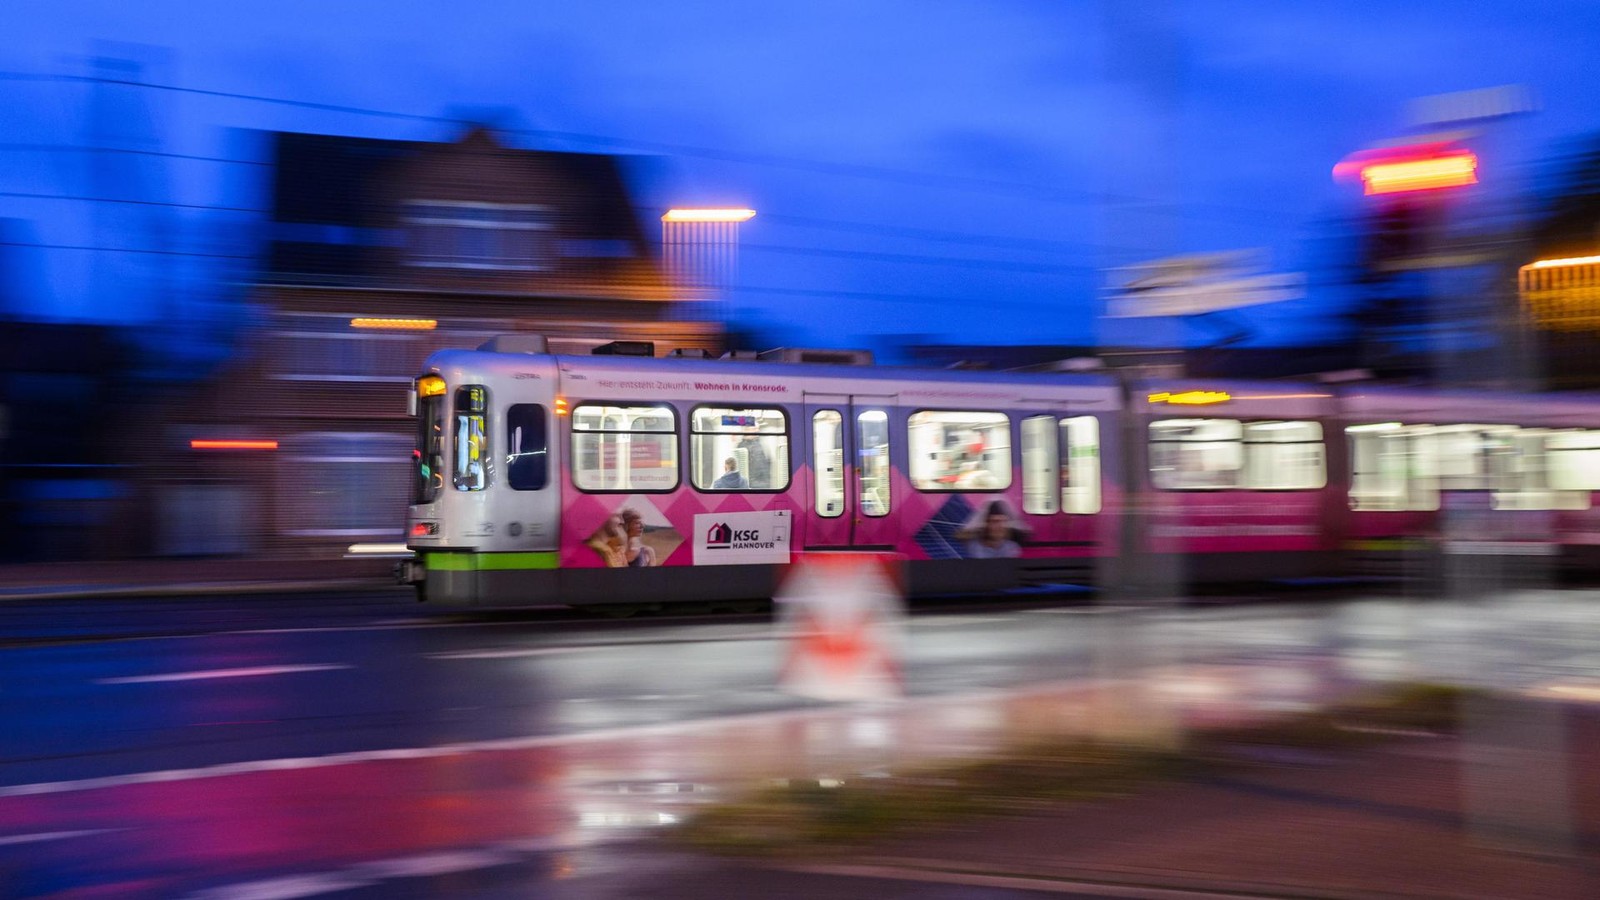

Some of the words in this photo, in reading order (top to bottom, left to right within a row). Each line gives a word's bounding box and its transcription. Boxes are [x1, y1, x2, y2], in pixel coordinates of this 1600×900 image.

[694, 383, 729, 391] Wohnen
[742, 384, 788, 393] Kronsrode.
[733, 530, 759, 541] KSG
